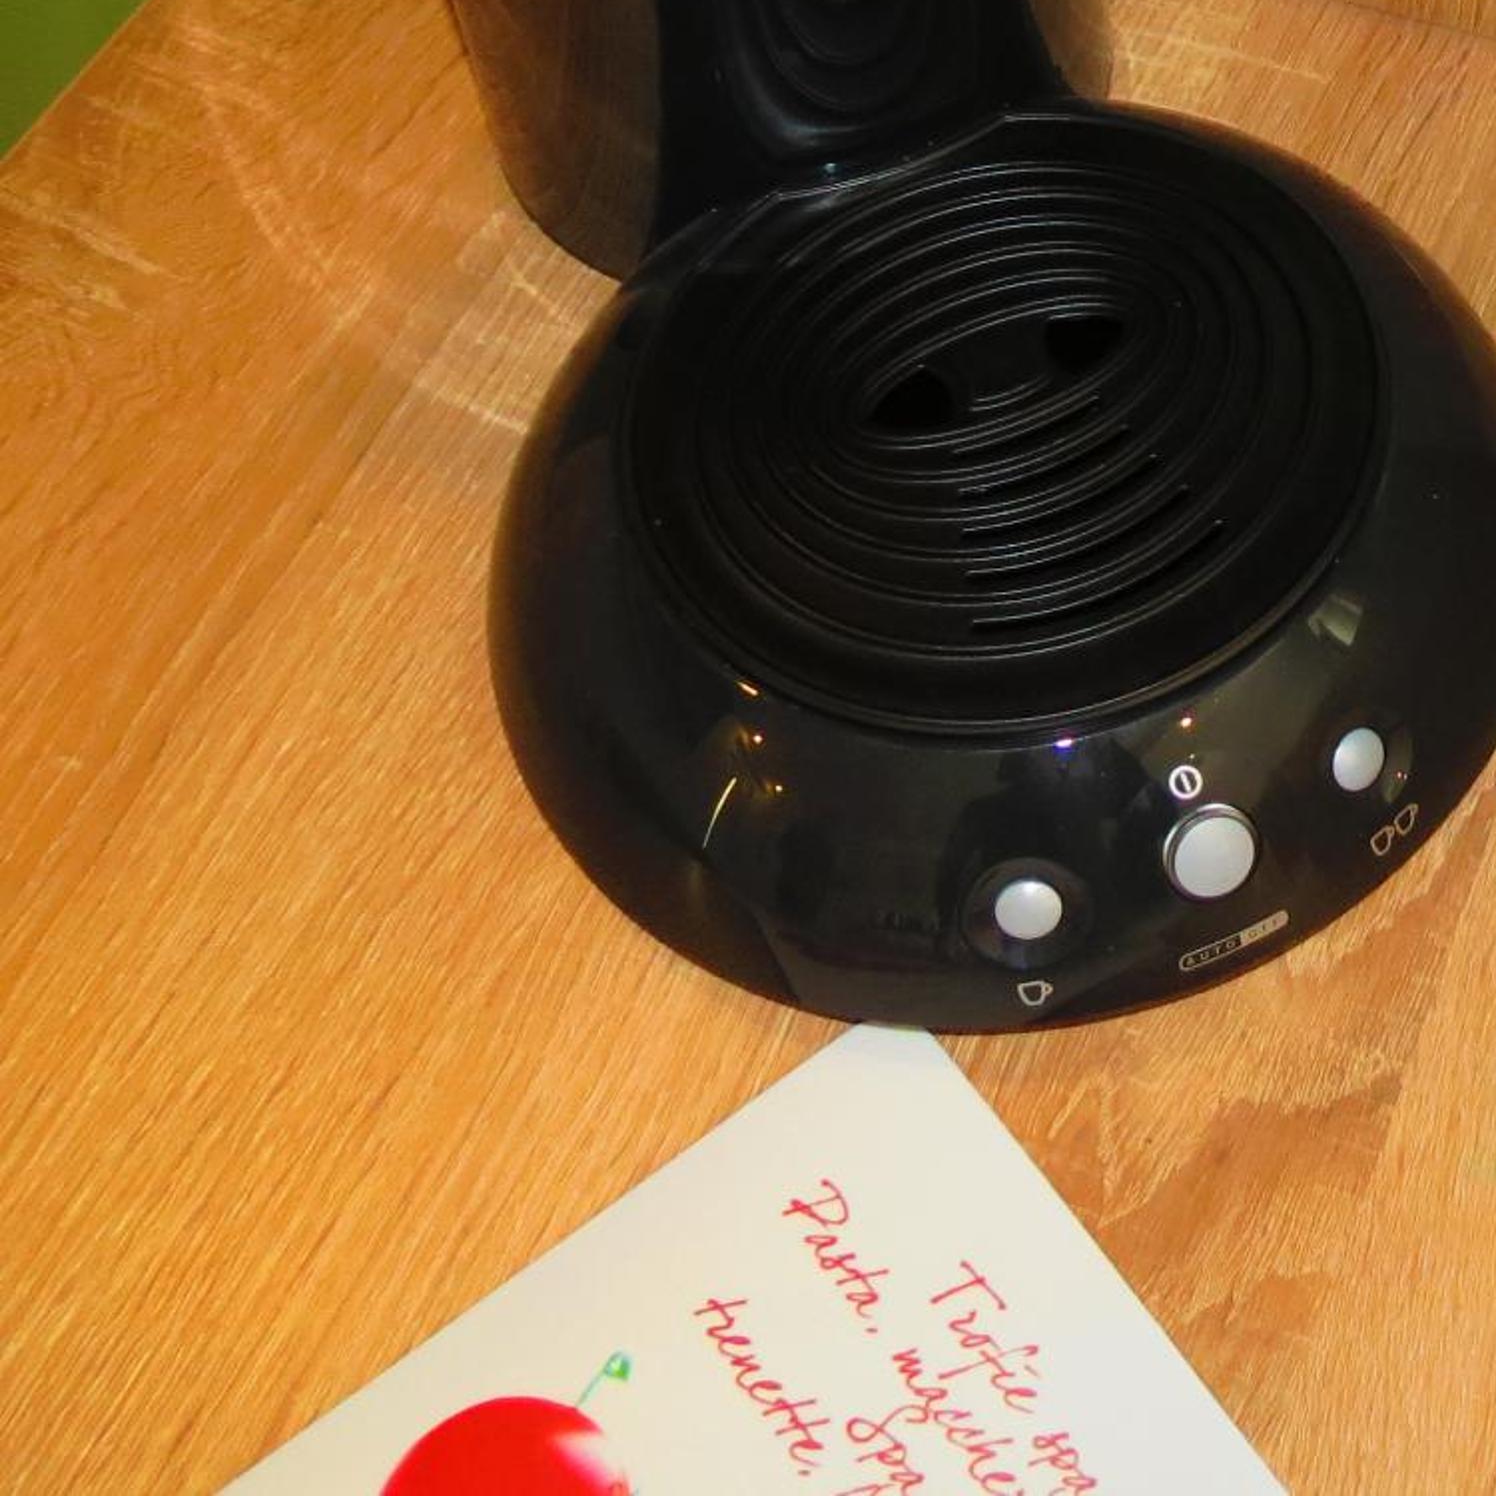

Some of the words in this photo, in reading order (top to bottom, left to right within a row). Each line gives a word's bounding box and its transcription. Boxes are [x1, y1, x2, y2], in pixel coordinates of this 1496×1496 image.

[1185, 937, 1237, 965] AUTO
[782, 1178, 890, 1335] Pasta.
[892, 1347, 1025, 1496] macche
[930, 1260, 1041, 1414] Trofie
[1027, 1431, 1098, 1496] spa
